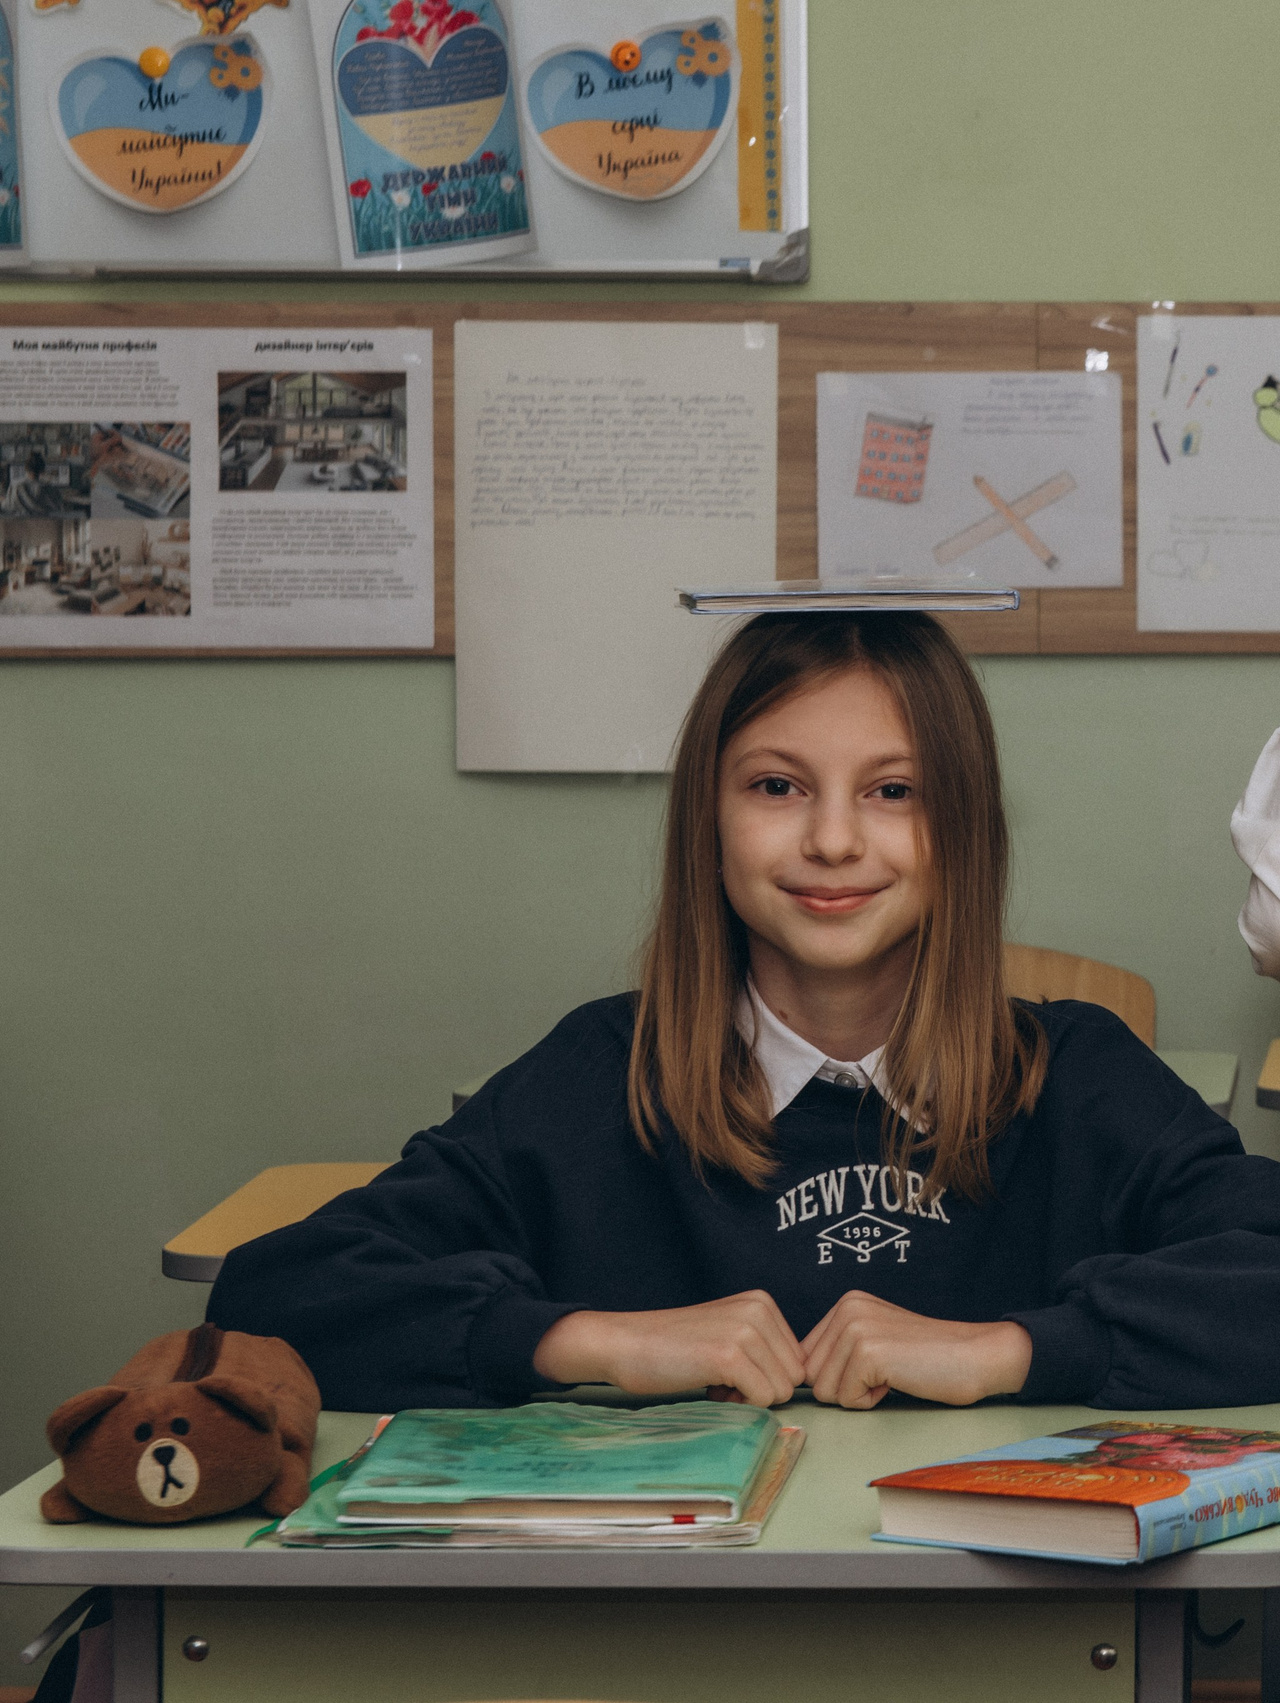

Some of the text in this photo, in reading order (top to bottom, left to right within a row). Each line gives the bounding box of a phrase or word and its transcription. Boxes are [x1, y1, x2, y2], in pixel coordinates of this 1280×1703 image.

[576, 71, 595, 99] В
[130, 159, 222, 195] України!
[598, 150, 684, 180] Україна
[775, 1163, 951, 1232] NEW YORK
[842, 1226, 882, 1239] 1996
